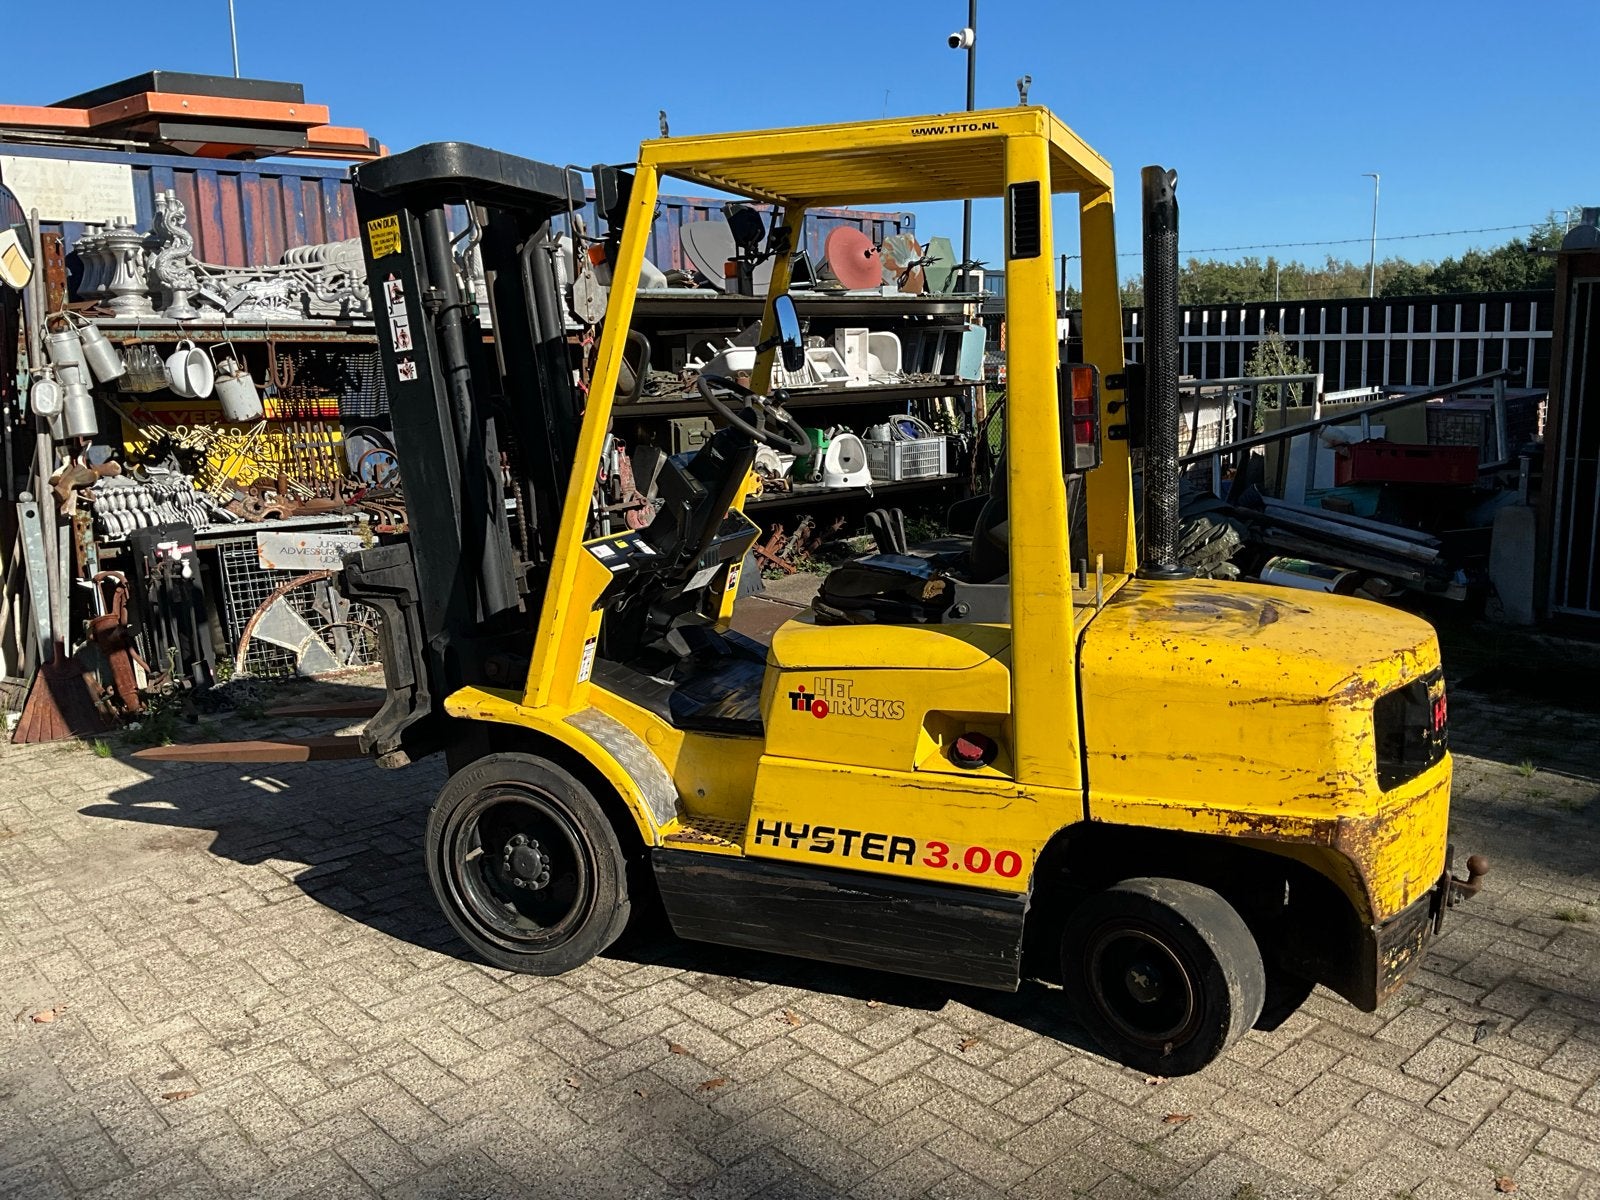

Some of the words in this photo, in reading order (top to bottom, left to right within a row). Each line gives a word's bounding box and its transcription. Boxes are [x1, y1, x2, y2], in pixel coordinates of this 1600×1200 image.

[911, 122, 999, 137] WWW.TITO.NL
[826, 697, 905, 720] TRUCKS
[754, 818, 916, 866] HYSTER
[922, 841, 1023, 878] 3.00
